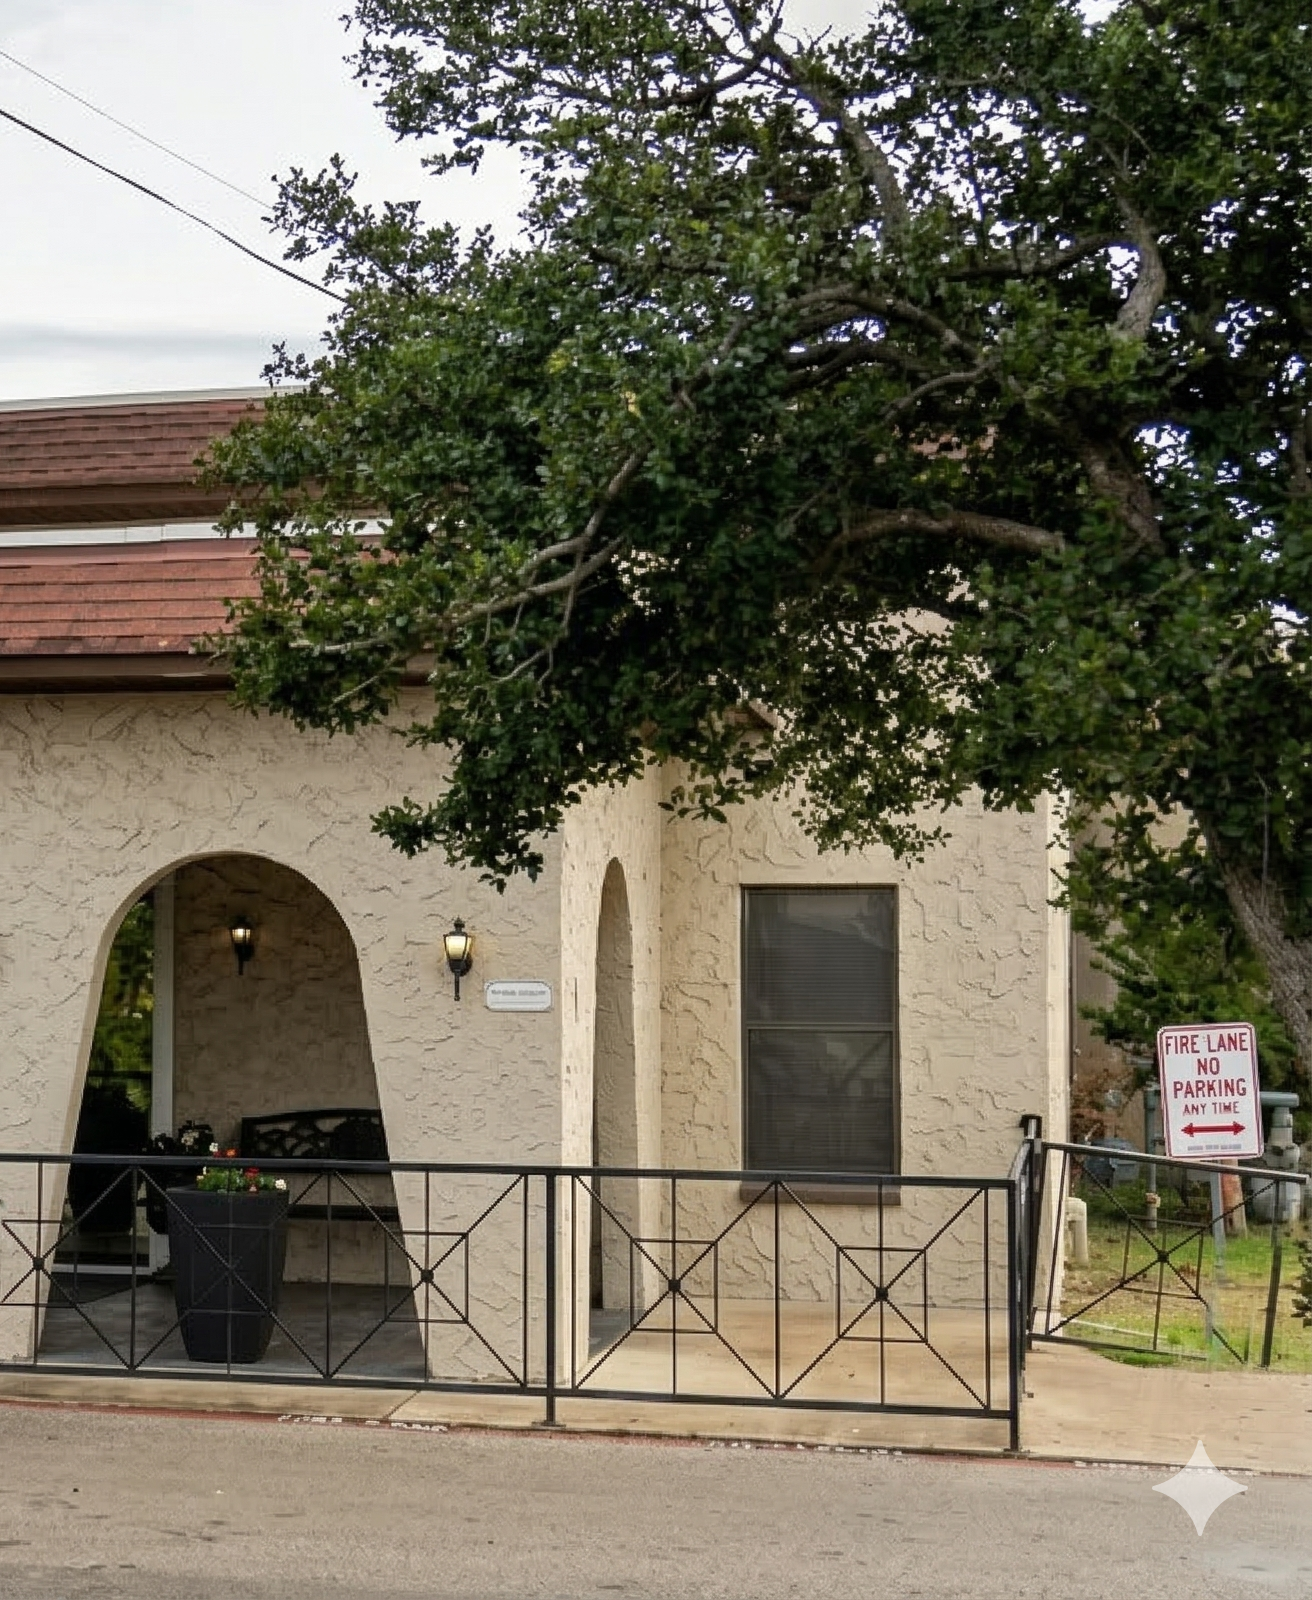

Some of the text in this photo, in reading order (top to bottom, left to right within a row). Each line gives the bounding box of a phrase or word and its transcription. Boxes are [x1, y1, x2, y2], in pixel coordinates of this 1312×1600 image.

[1165, 1032, 1248, 1055] FIRE LANE
[1197, 1057, 1220, 1076] NO
[1173, 1078, 1247, 1099] PARKING
[1183, 1101, 1240, 1116] ANY TIME
